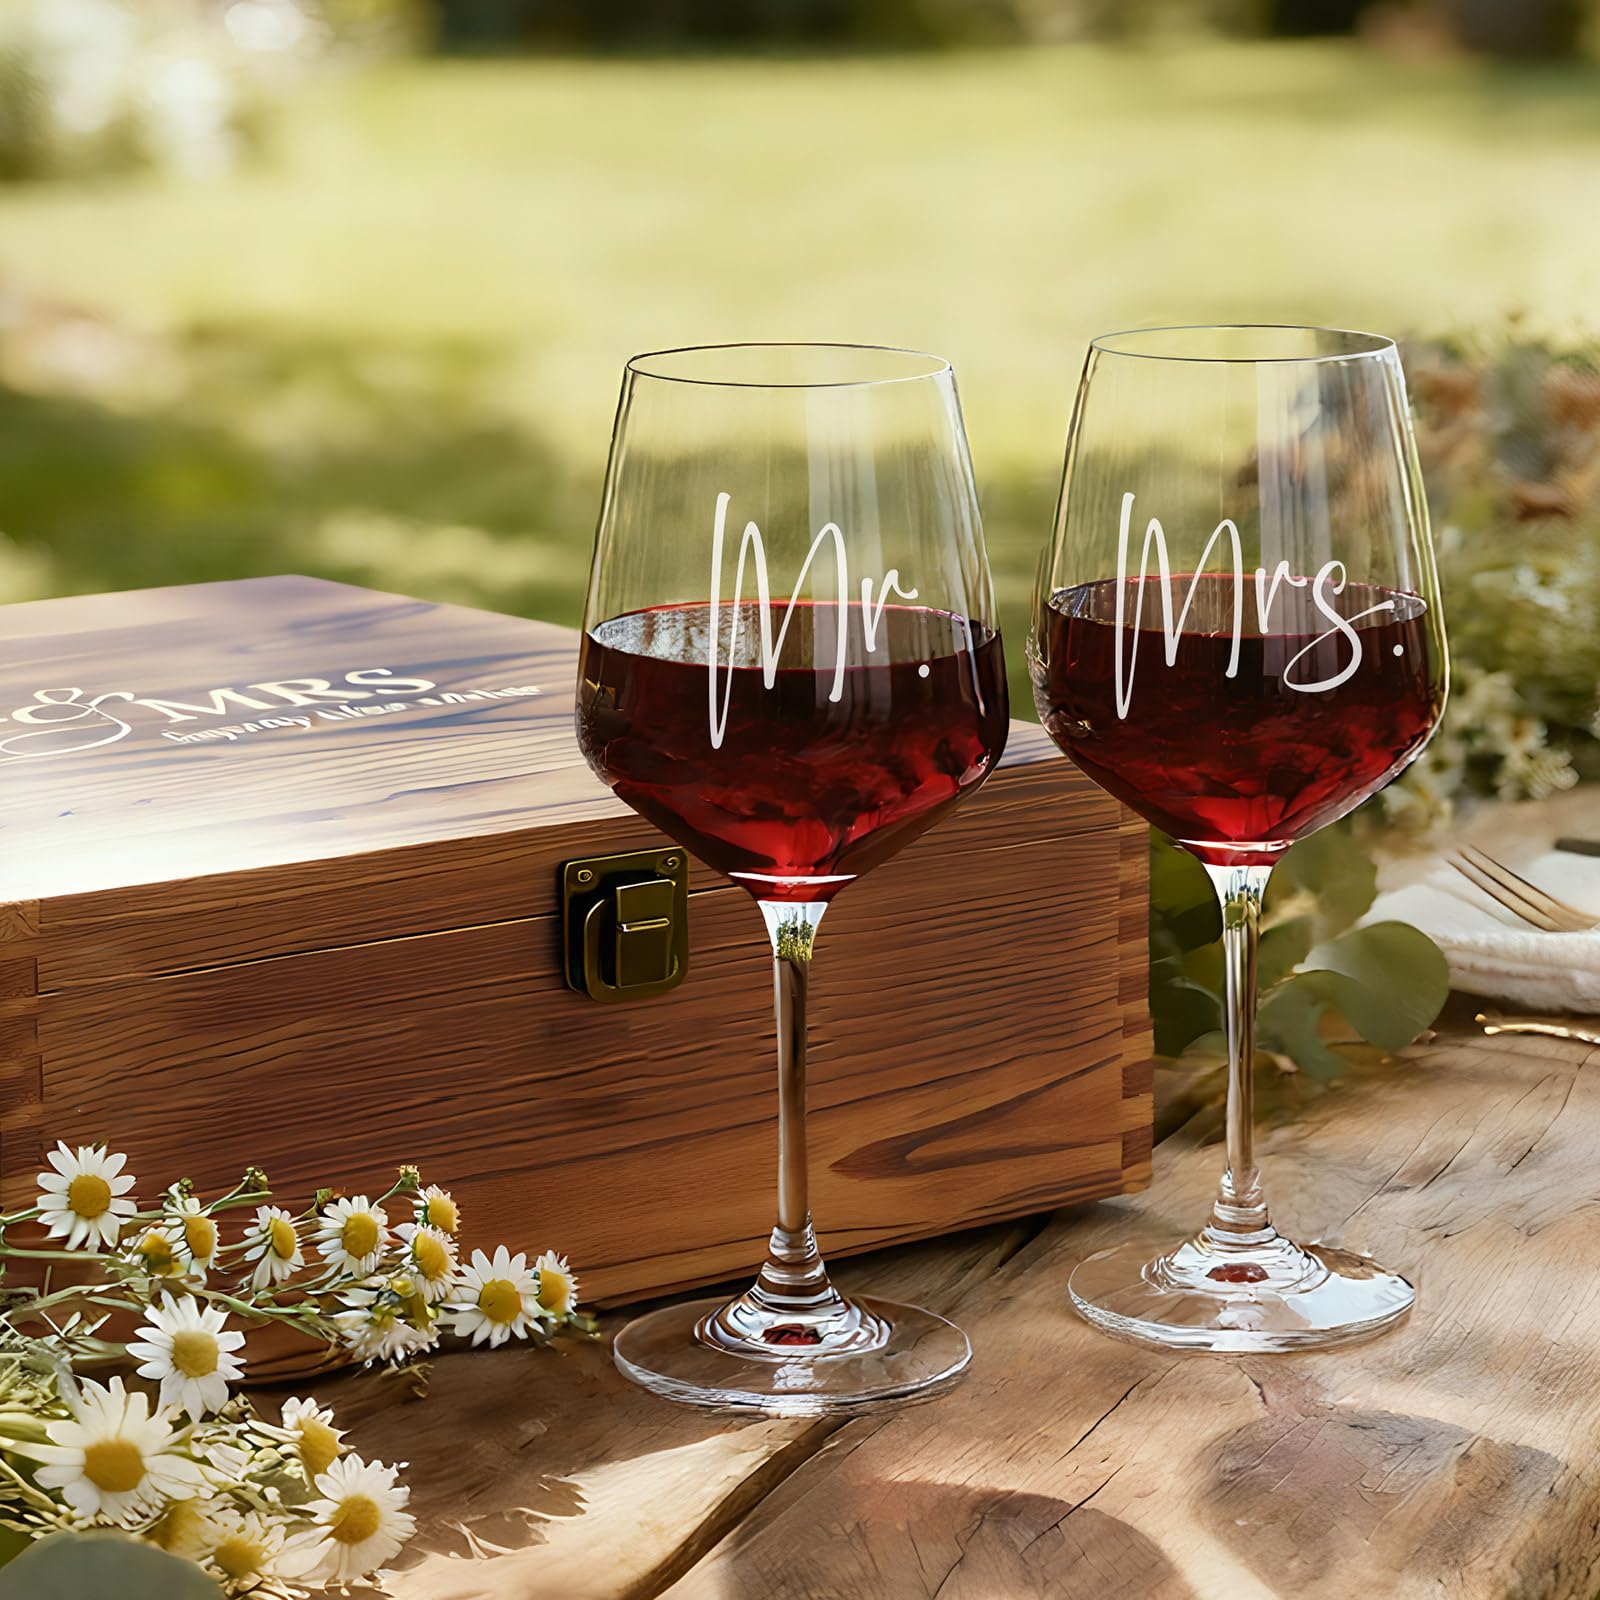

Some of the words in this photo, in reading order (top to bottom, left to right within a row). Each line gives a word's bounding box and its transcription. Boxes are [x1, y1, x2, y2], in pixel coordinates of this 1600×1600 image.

[0, 687, 135, 761] &
[131, 668, 437, 723] MRS
[708, 491, 931, 750] Mr.
[1115, 492, 1404, 720] Mrs.
